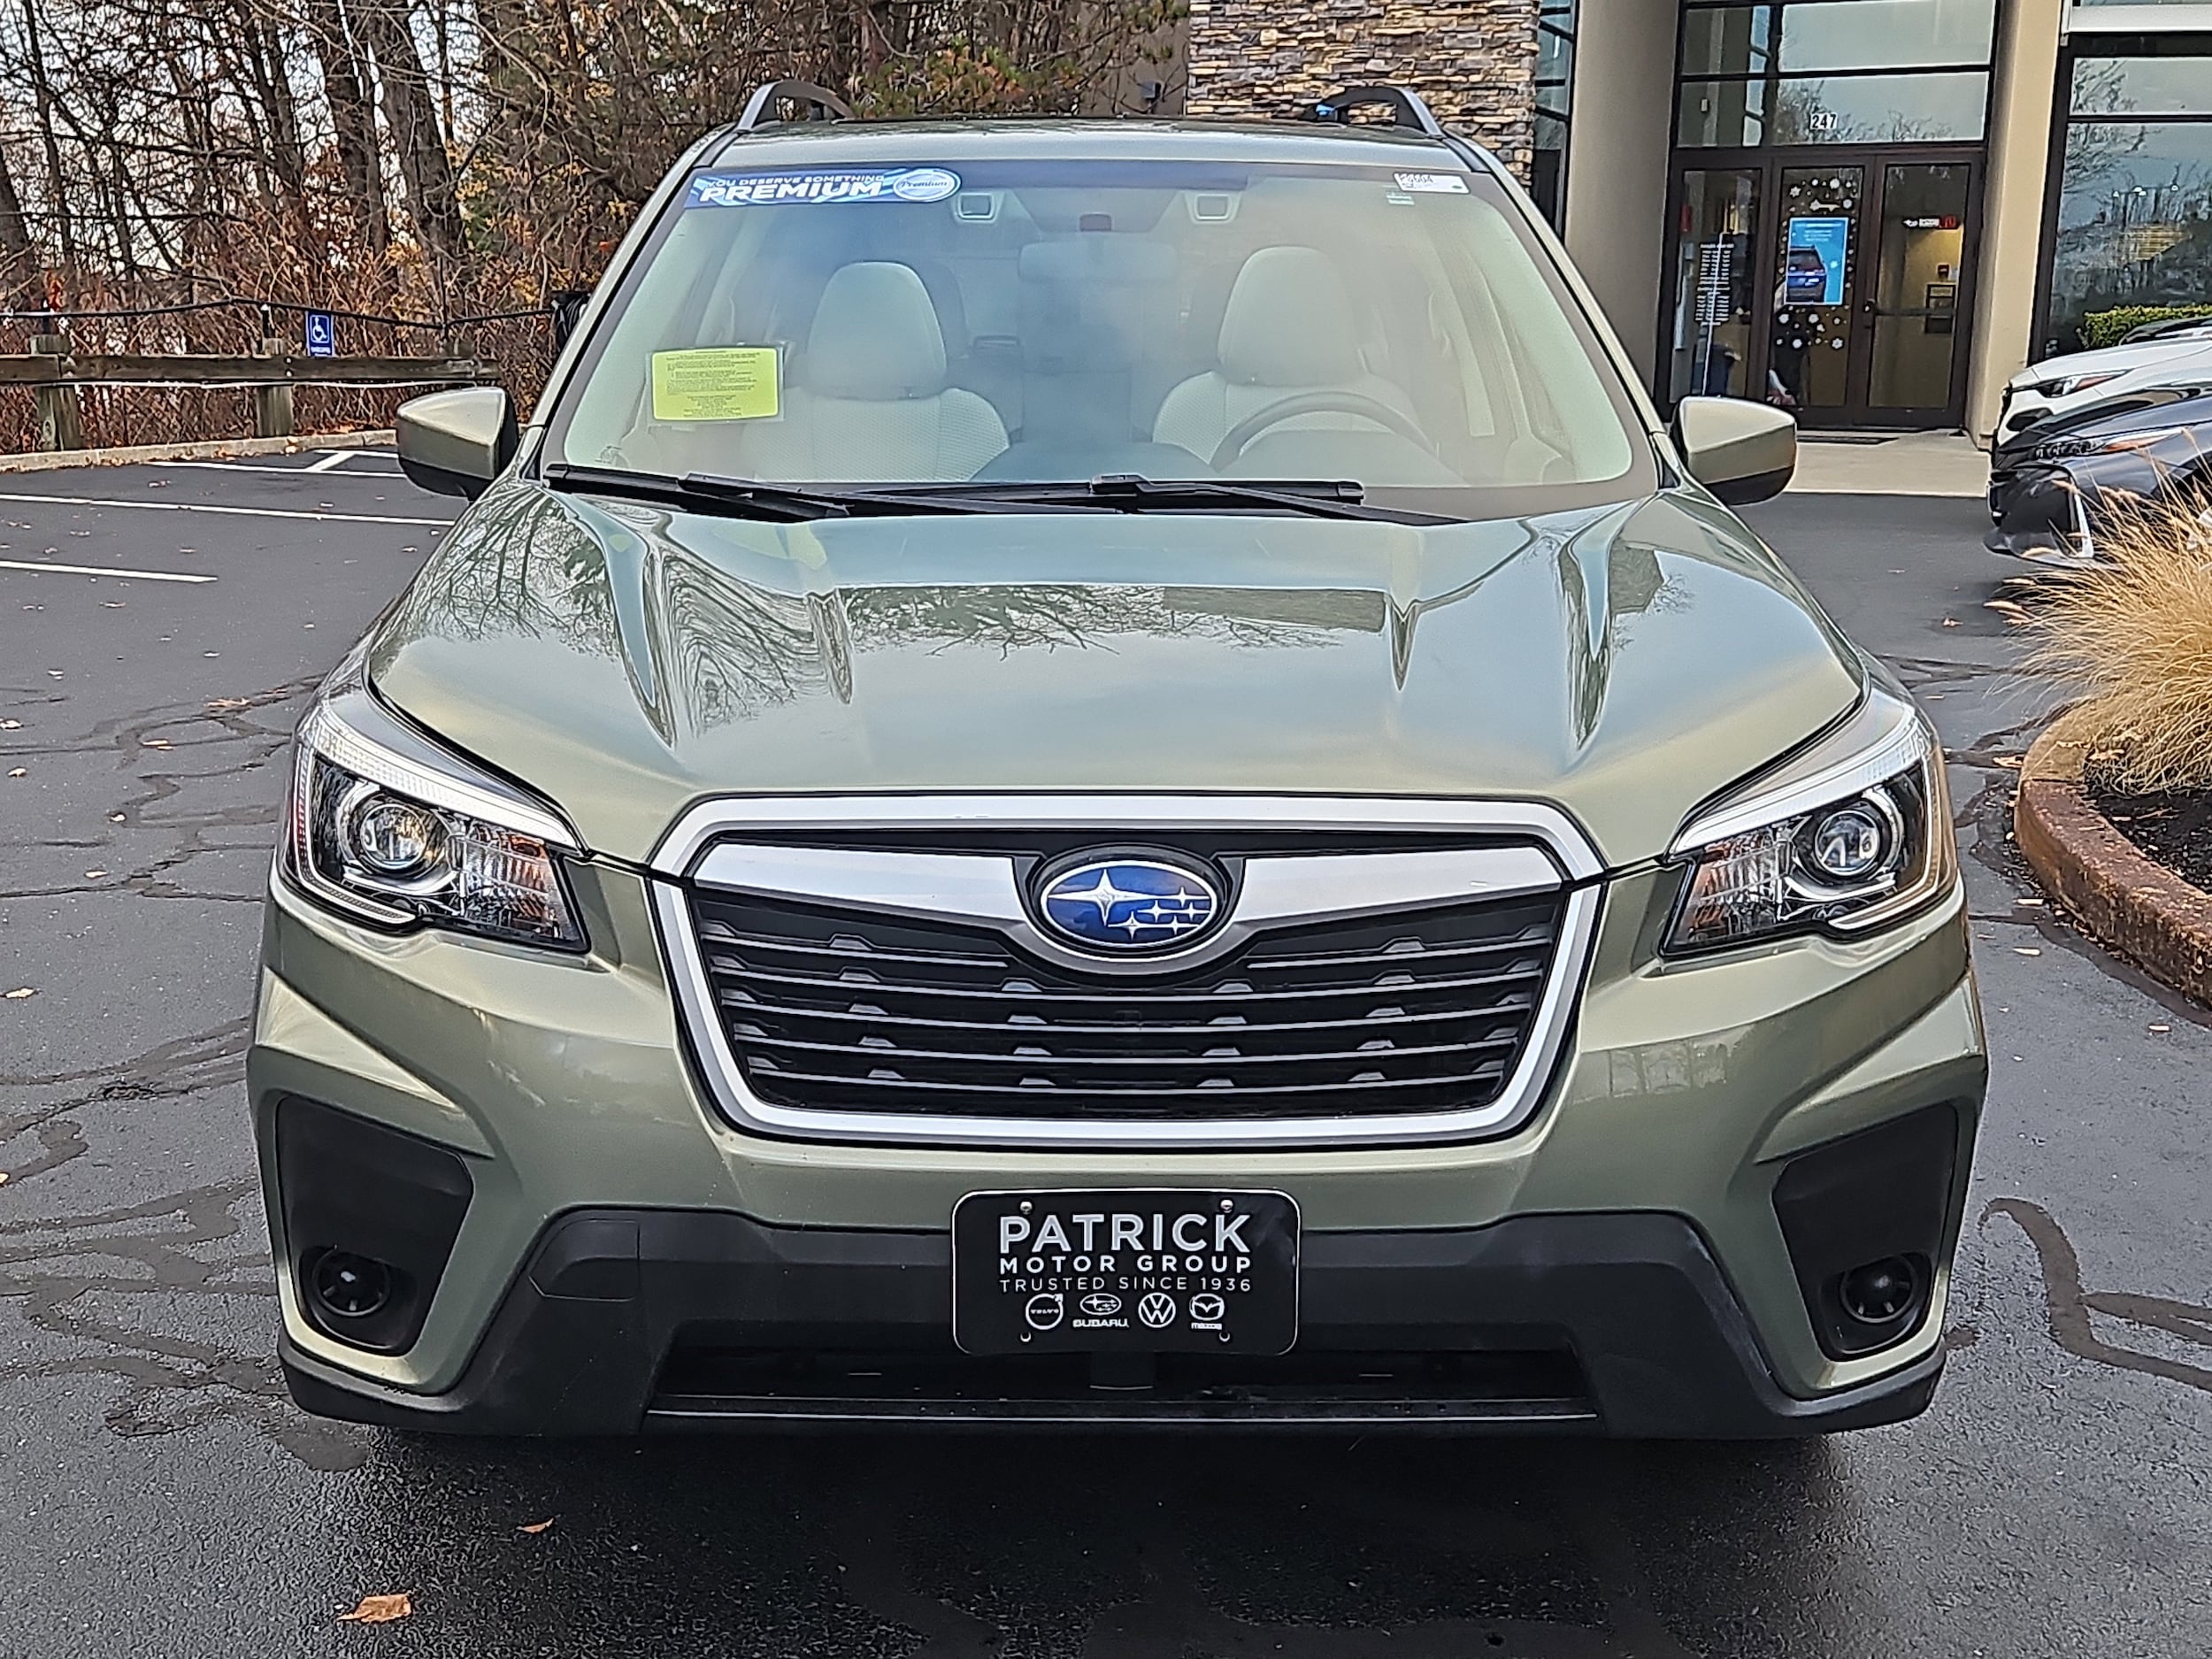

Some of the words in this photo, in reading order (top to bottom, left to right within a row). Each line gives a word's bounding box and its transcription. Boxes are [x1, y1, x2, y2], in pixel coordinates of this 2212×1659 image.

[1812, 114, 1836, 128] 247
[708, 179, 735, 188] YOU
[739, 177, 802, 186] DESERVE
[804, 174, 885, 183] SOMETHING
[700, 181, 881, 202] PREMIUM
[1001, 1215, 1249, 1253] PATRICK
[1001, 1256, 1115, 1274] MOTOR
[1137, 1256, 1250, 1273] GROUP
[1000, 1278, 1104, 1292] TRUSTED
[1119, 1277, 1187, 1289] SINCE
[1202, 1278, 1250, 1291] 1936
[1073, 1318, 1129, 1327] SUBARU
